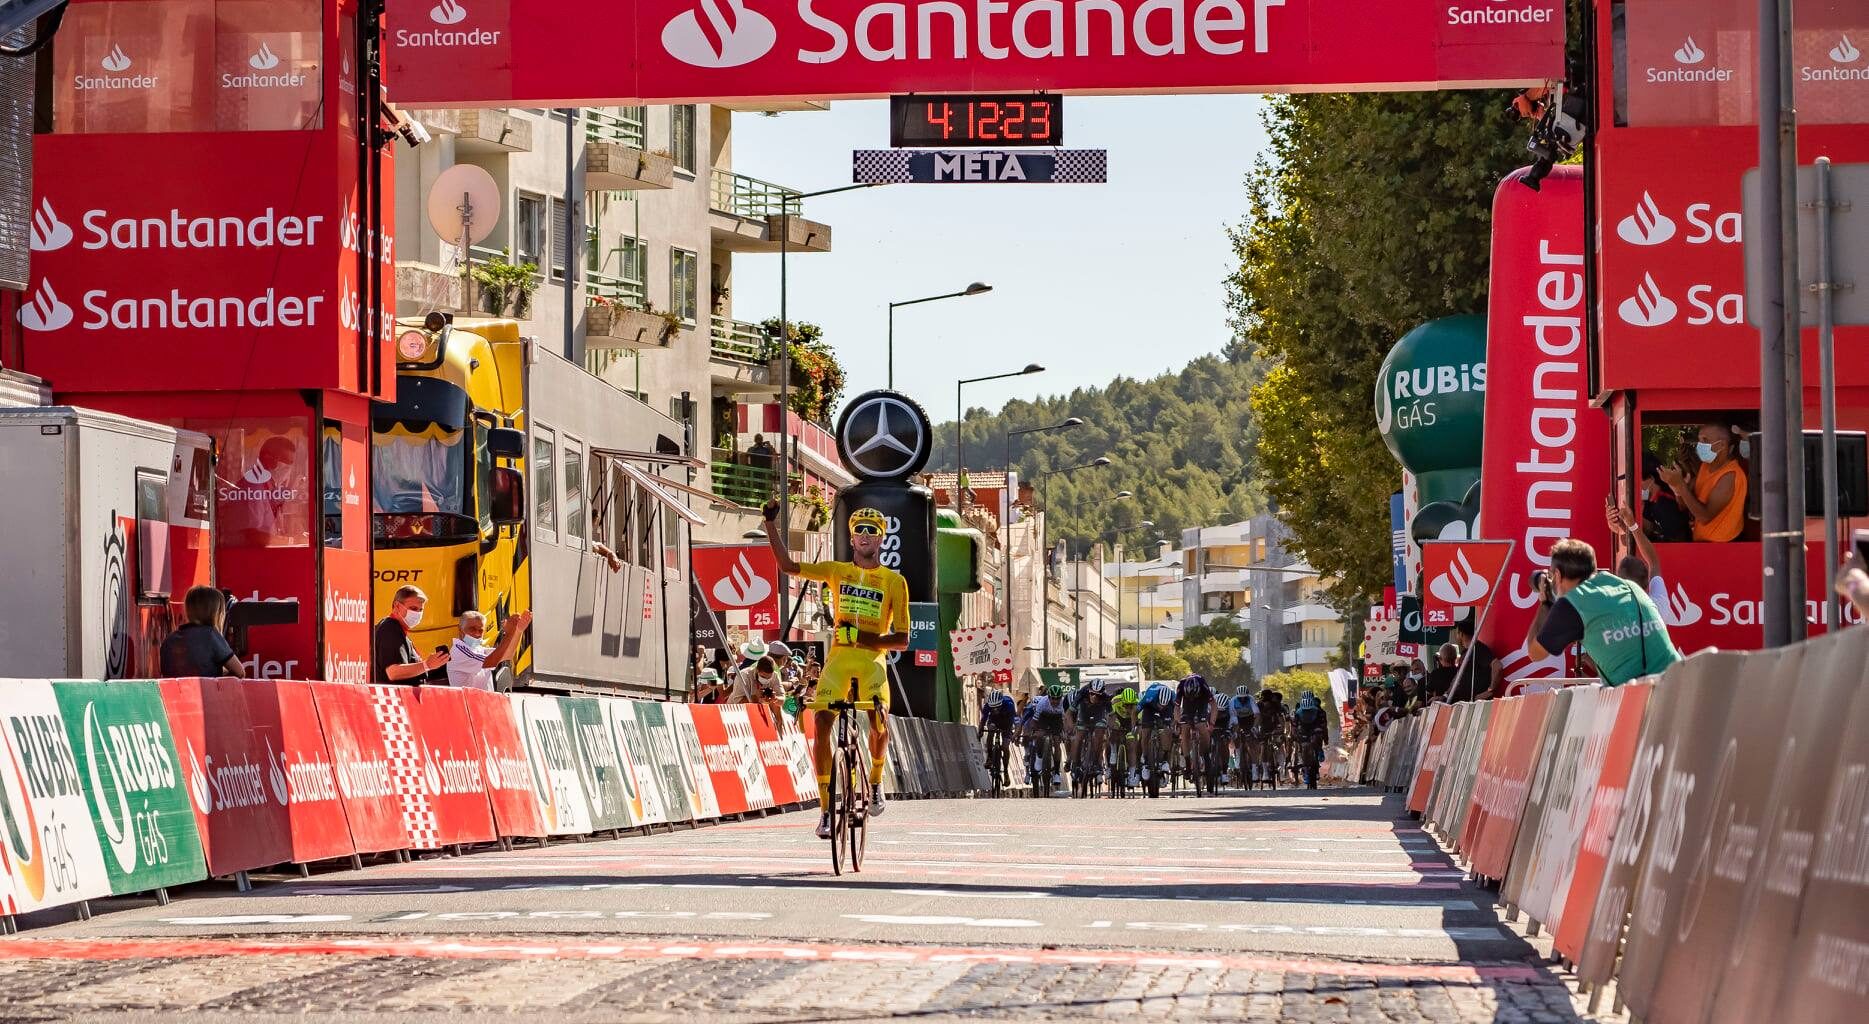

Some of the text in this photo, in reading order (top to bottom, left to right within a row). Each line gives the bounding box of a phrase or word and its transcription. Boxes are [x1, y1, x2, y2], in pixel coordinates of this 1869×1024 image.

[1447, 3, 1553, 25] Santander
[396, 27, 501, 47] Santander
[798, 0, 1285, 64] Santander
[74, 75, 159, 90] Santander
[222, 73, 306, 88] Santander
[1646, 66, 1733, 82] Santander
[1801, 66, 1869, 81] Santand
[927, 101, 1051, 139] 4:12:23
[933, 153, 1027, 182] META
[82, 207, 324, 250] Santander
[82, 287, 324, 330] Santander
[1397, 399, 1436, 429] GÁS
[219, 485, 298, 501] Santander
[841, 585, 880, 601] EFAPEL
[333, 590, 368, 624] Santander
[754, 612, 774, 625] 25.
[1428, 610, 1449, 622] 25.
[910, 620, 936, 631] UBiS
[1602, 620, 1664, 646] Fotógra
[919, 653, 934, 664] 50.
[205, 754, 268, 811] Santander
[280, 751, 337, 804] Santander
[342, 749, 394, 800] Santander
[434, 748, 484, 795] Santander
[136, 798, 168, 866] GÁS
[43, 809, 78, 893] GÁS
